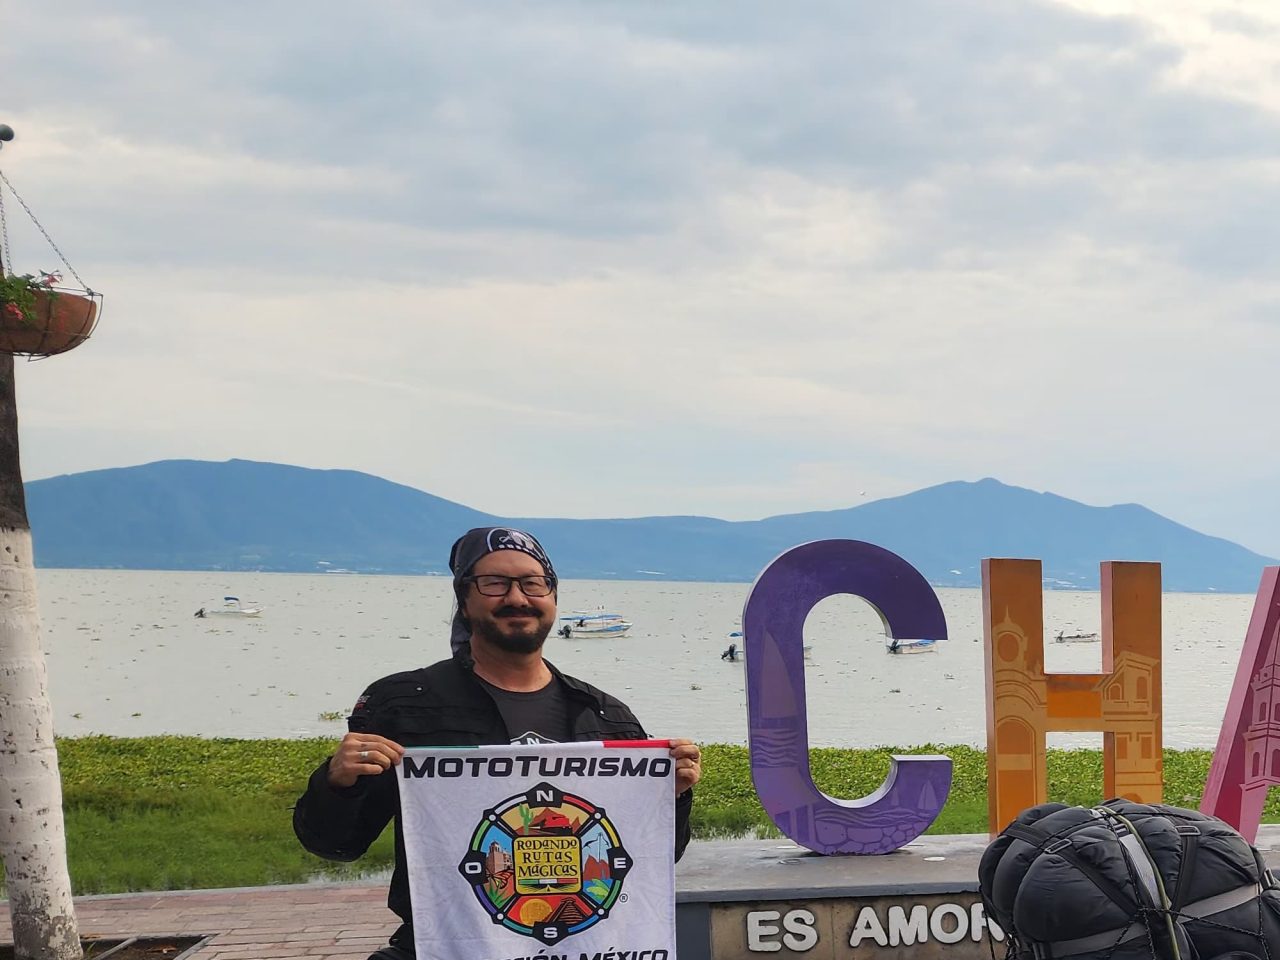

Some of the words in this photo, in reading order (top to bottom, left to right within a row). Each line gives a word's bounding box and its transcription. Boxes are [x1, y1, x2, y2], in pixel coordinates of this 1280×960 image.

[536, 790, 554, 802] N
[613, 857, 627, 869] E
[543, 927, 558, 939] S
[746, 909, 819, 952] ES
